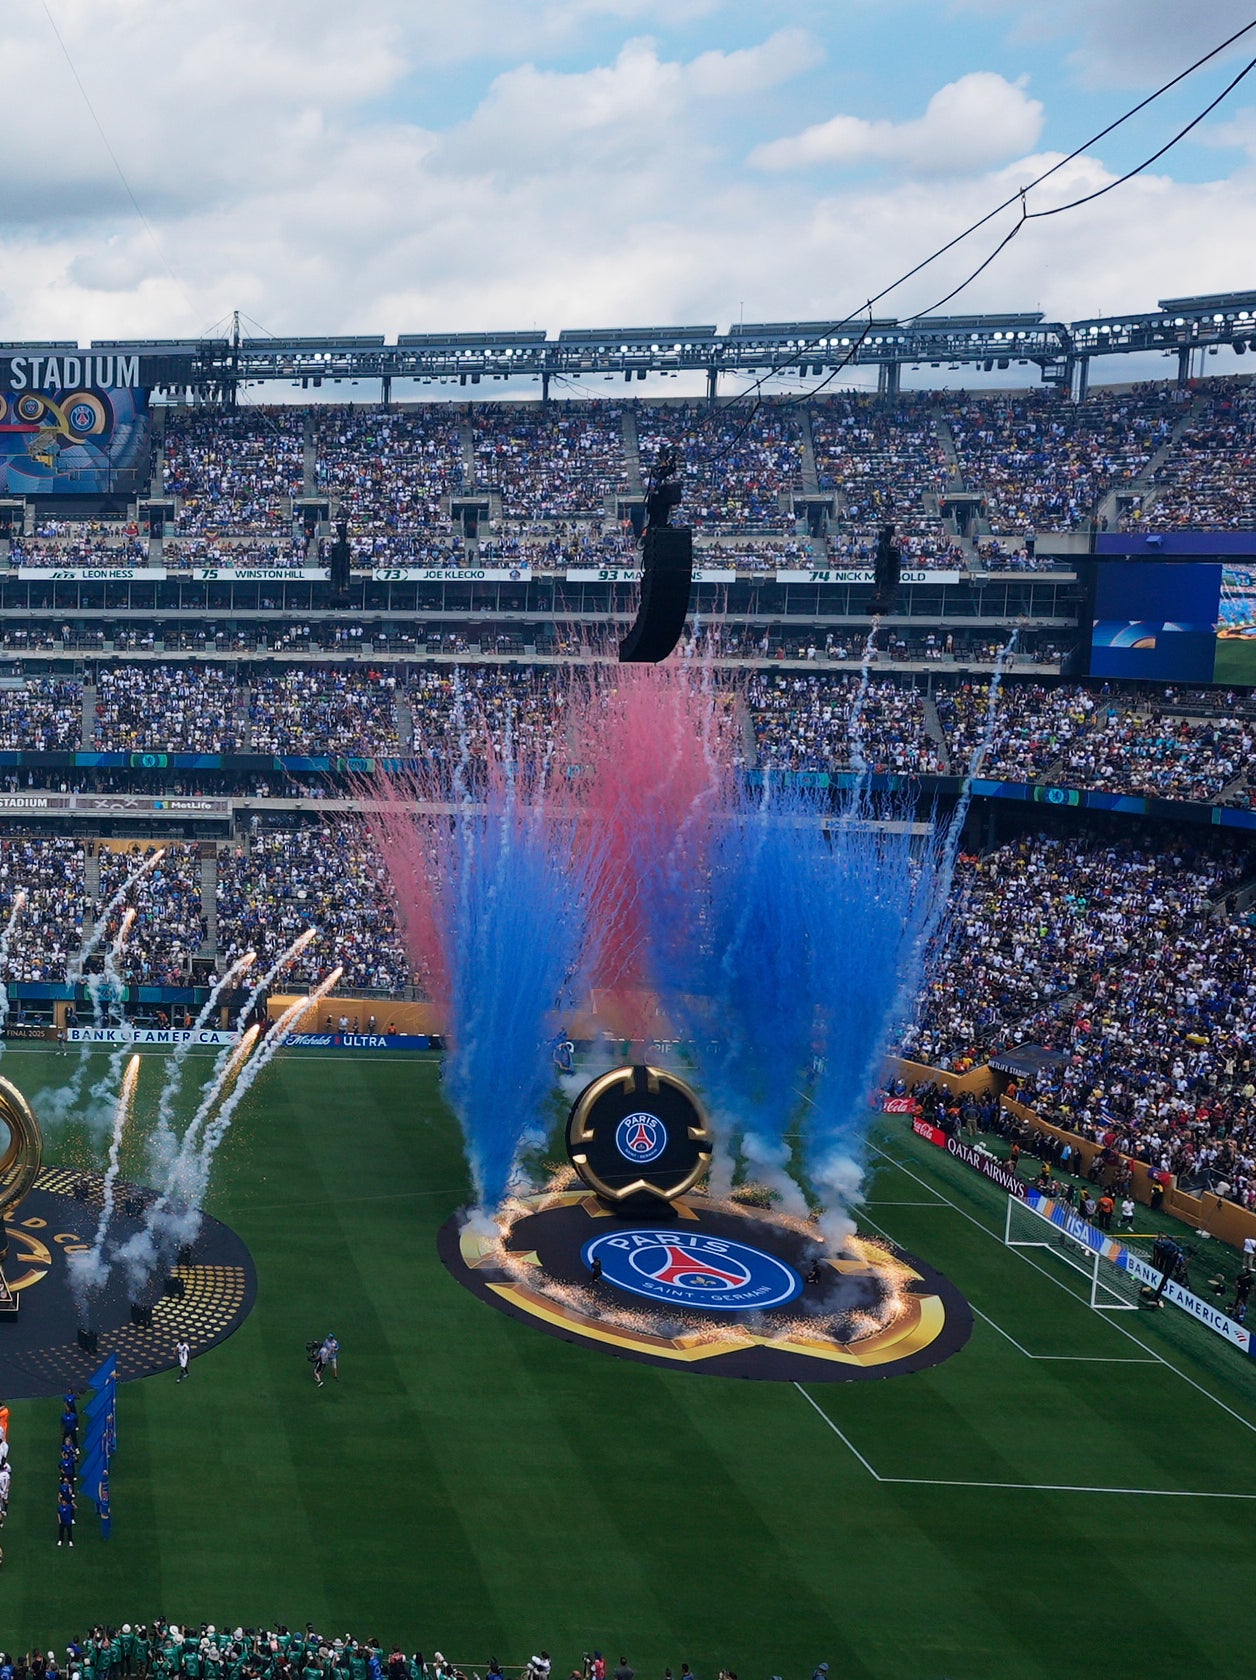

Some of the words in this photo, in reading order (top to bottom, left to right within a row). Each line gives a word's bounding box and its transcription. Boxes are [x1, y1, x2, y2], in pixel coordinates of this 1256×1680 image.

[10, 355, 140, 390] STADIUM
[82, 570, 107, 578] LEON
[109, 569, 134, 578] HESS
[202, 569, 219, 579] 75
[235, 570, 283, 578] WINSTON
[284, 570, 305, 578] HILL
[383, 570, 401, 580] 73
[423, 570, 443, 579] JOE
[445, 570, 485, 579] KLECKO
[598, 570, 619, 580] 93
[809, 571, 831, 581] 74
[836, 572, 862, 581] NICK
[865, 572, 926, 581] MOLD
[71, 1030, 116, 1040] BANK
[145, 1031, 220, 1043] AMERCA
[286, 1034, 332, 1046] Michelob
[343, 1036, 387, 1047] ULTRA
[624, 1115, 658, 1128] PARIS
[947, 1138, 980, 1169] QATAR
[982, 1161, 1025, 1198] AIRWAYS
[53, 1232, 90, 1256] CU
[606, 1233, 731, 1254] PARIS
[642, 1281, 695, 1299] SAINT
[710, 1285, 772, 1301] GERMAIN
[1128, 1257, 1157, 1285] BANK
[1176, 1292, 1230, 1335] AMERICA
